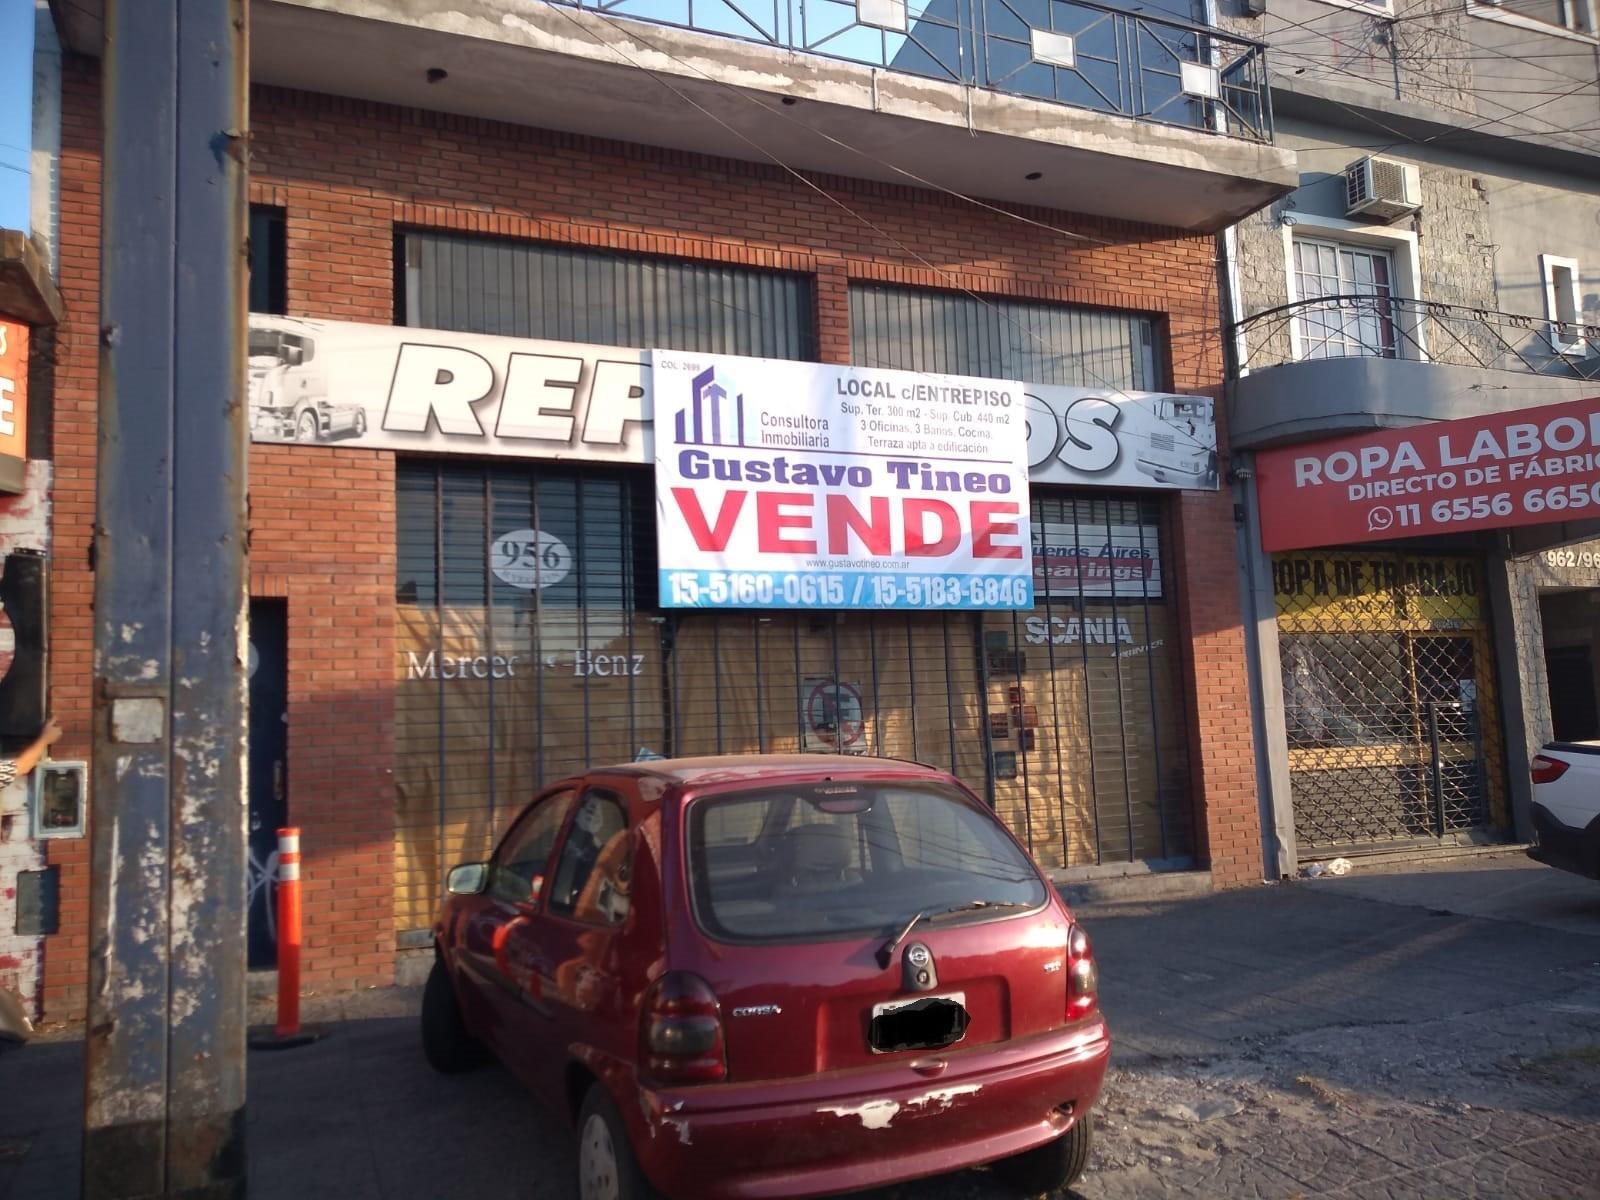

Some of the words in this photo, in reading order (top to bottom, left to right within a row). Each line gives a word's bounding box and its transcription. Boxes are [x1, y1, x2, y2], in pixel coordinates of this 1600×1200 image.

[837, 378, 896, 399] LOCAL
[901, 384, 1012, 408] c/ENTREPISO
[760, 411, 829, 431] Consultora
[840, 401, 864, 416] Sup.
[887, 405, 904, 417] 300
[906, 407, 921, 418] m2
[996, 413, 1010, 425] m2
[860, 419, 867, 431] 3
[915, 422, 921, 434] 3
[761, 430, 830, 448] Inmobiliaria
[867, 435, 904, 449] Terraza
[906, 438, 927, 452] apta
[1294, 440, 1426, 488] ROPA
[1438, 412, 1600, 467] LABO
[678, 449, 872, 488] Gustavo
[886, 461, 1012, 494] Tineo
[1348, 471, 1457, 501] DIRECTO
[1464, 465, 1502, 487] DE
[1508, 452, 1600, 481] FÁBRI
[670, 487, 1024, 560] VENDE
[1395, 503, 1421, 527] 11
[1431, 492, 1513, 523] 6556
[502, 541, 561, 568] 956
[805, 557, 910, 569] www.gustavotineo.com.ar
[1098, 542, 1151, 559] Aires
[669, 573, 844, 606] 15-5160-0615
[852, 576, 866, 605] /
[870, 576, 1027, 607] 15-5183-6846
[1334, 560, 1364, 593] DE
[1369, 560, 1477, 596] TRABAJO
[1024, 616, 1134, 645] SCANIA
